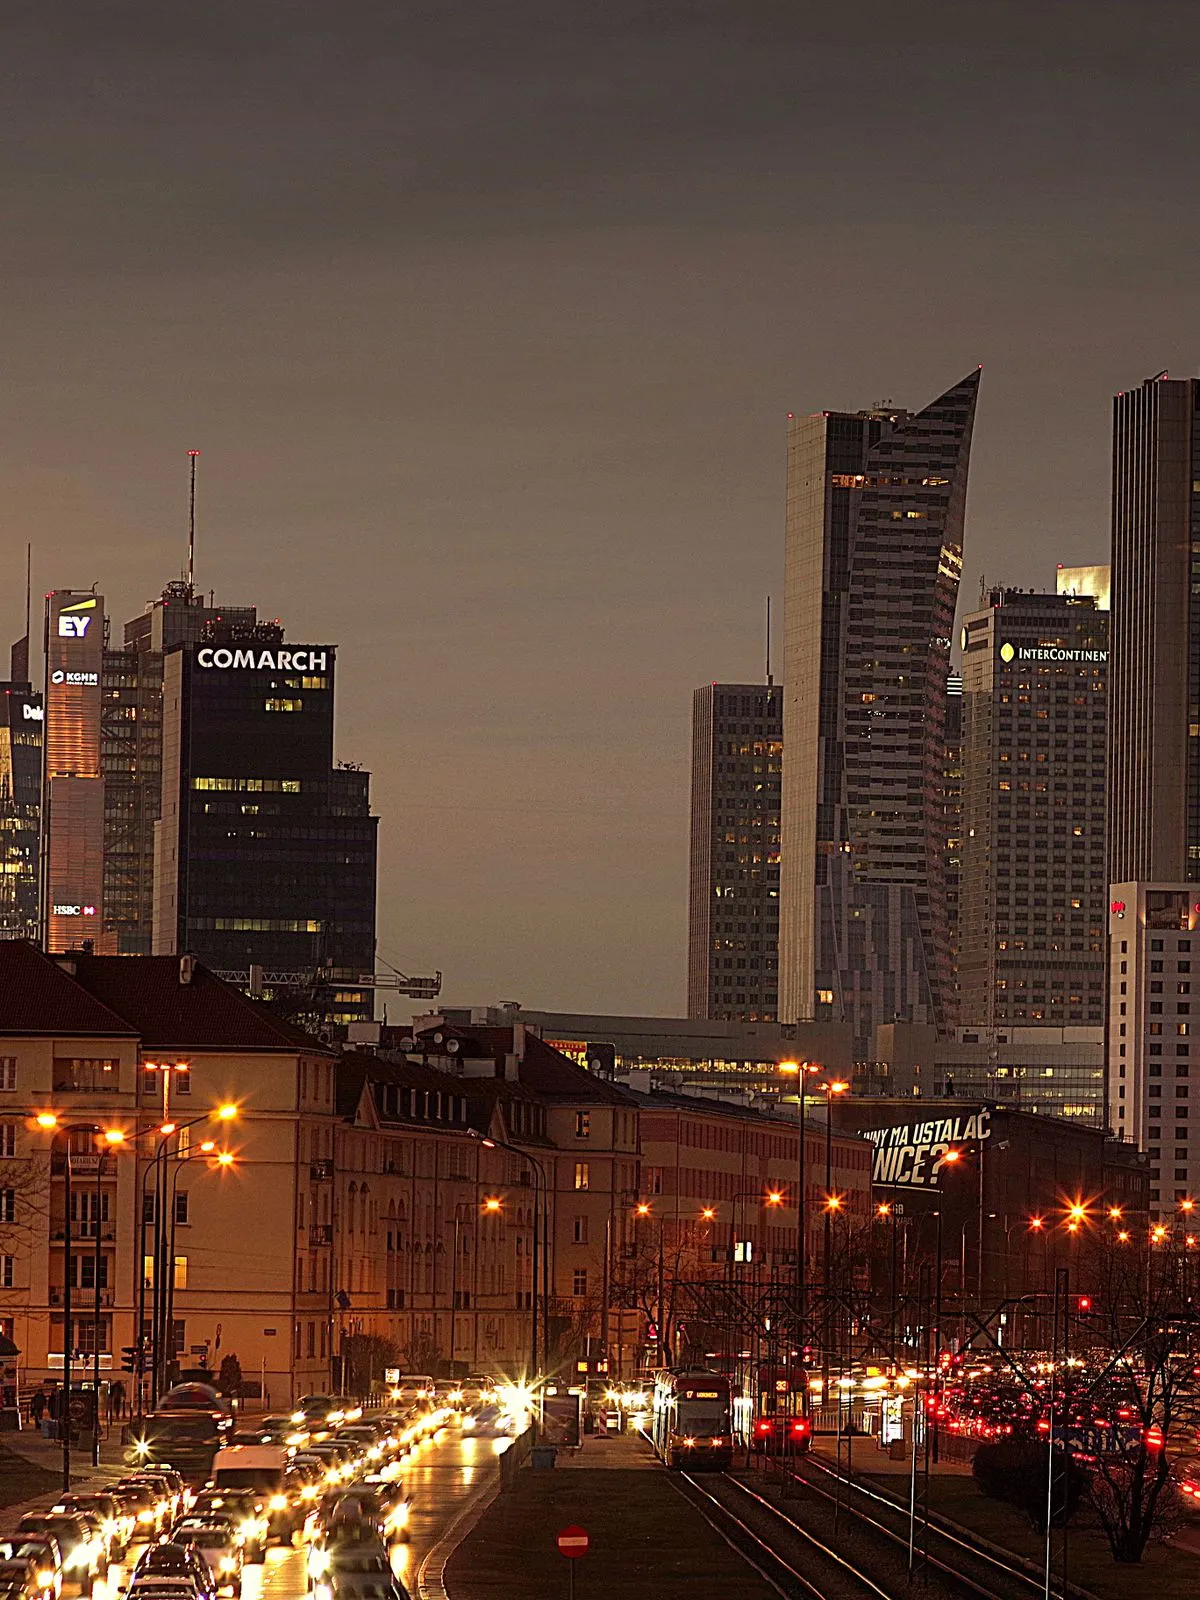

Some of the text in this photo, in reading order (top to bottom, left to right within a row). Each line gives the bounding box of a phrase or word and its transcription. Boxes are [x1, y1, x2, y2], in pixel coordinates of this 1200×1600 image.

[58, 616, 91, 637] EY
[198, 648, 327, 671] COMARCH
[66, 673, 98, 682] KGHM
[53, 905, 80, 915] HSBC
[889, 1126, 909, 1146] MA
[912, 1107, 991, 1144] USTALAĆ
[871, 1143, 950, 1184] NICE?
